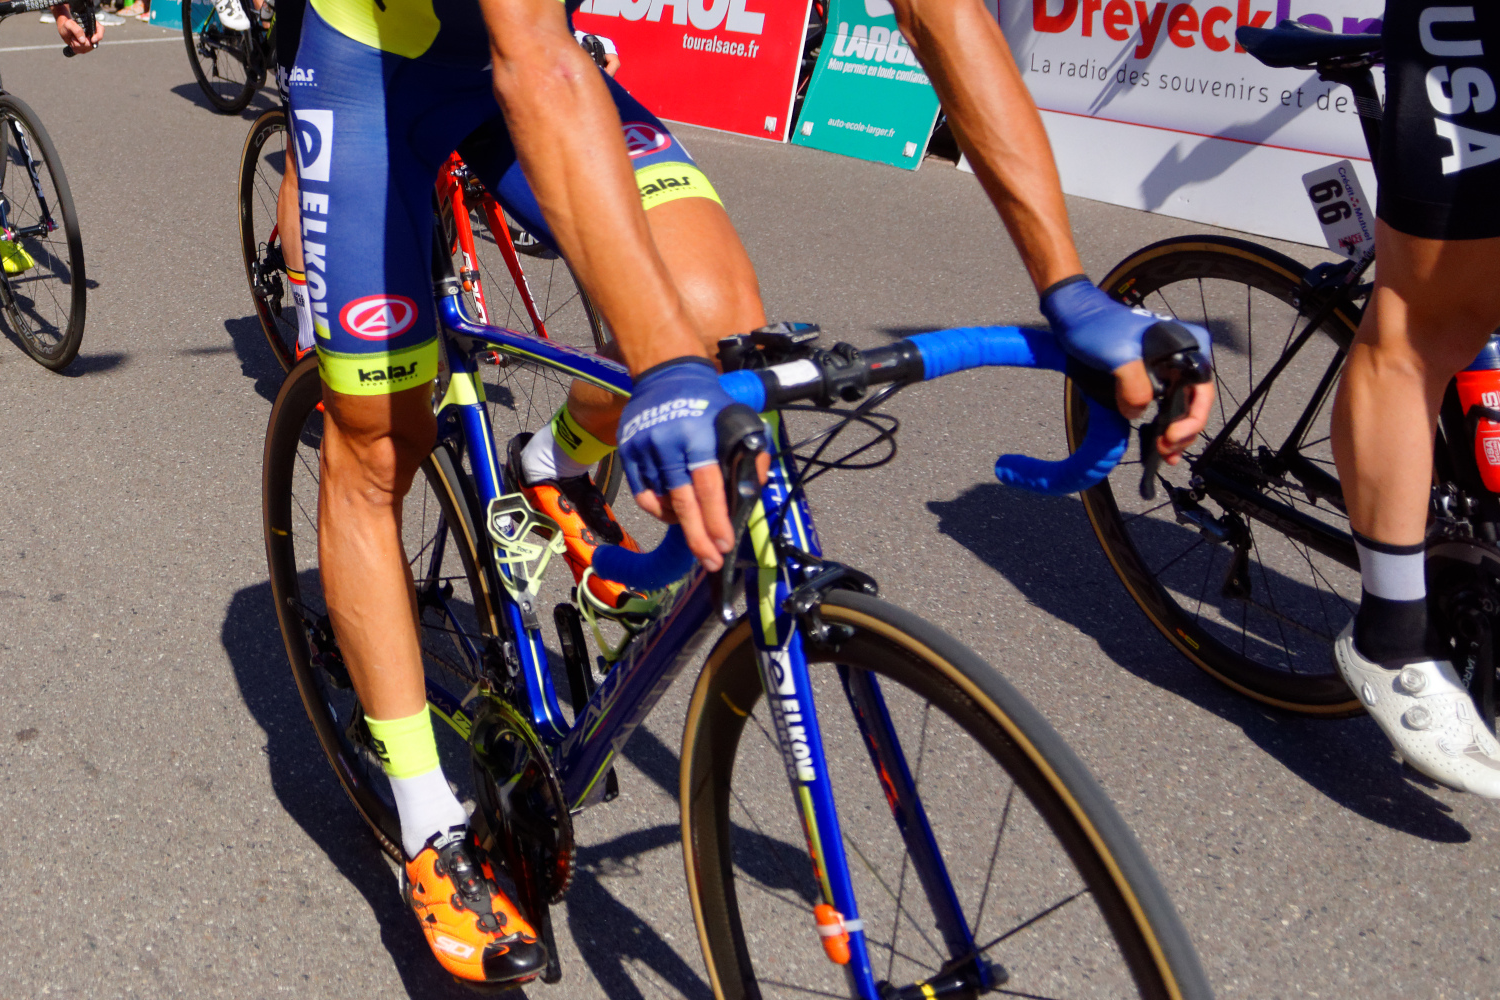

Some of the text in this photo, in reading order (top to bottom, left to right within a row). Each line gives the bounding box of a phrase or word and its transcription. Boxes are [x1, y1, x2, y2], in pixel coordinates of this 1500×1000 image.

[682, 33, 760, 59] touralsace.fr
[827, 57, 929, 85] Mon permis en toute confiance
[1030, 53, 1050, 74] La
[1059, 60, 1107, 82] radio
[1116, 63, 1150, 88] des
[1158, 71, 1269, 104] souvenirs
[1280, 87, 1304, 109] et
[1418, 6, 1500, 175] USA
[827, 117, 896, 138] auto-ecole-larger.fr
[1308, 178, 1352, 226] 66
[1338, 167, 1373, 241] Crédit Mutuel
[302, 190, 331, 340] ELKOV
[357, 361, 418, 384] kalas
[359, 373, 419, 387] SPORTSWEAR
[637, 408, 705, 433] ELEKTRO
[641, 400, 709, 423] ELKOV
[782, 698, 817, 782] ELKOV
